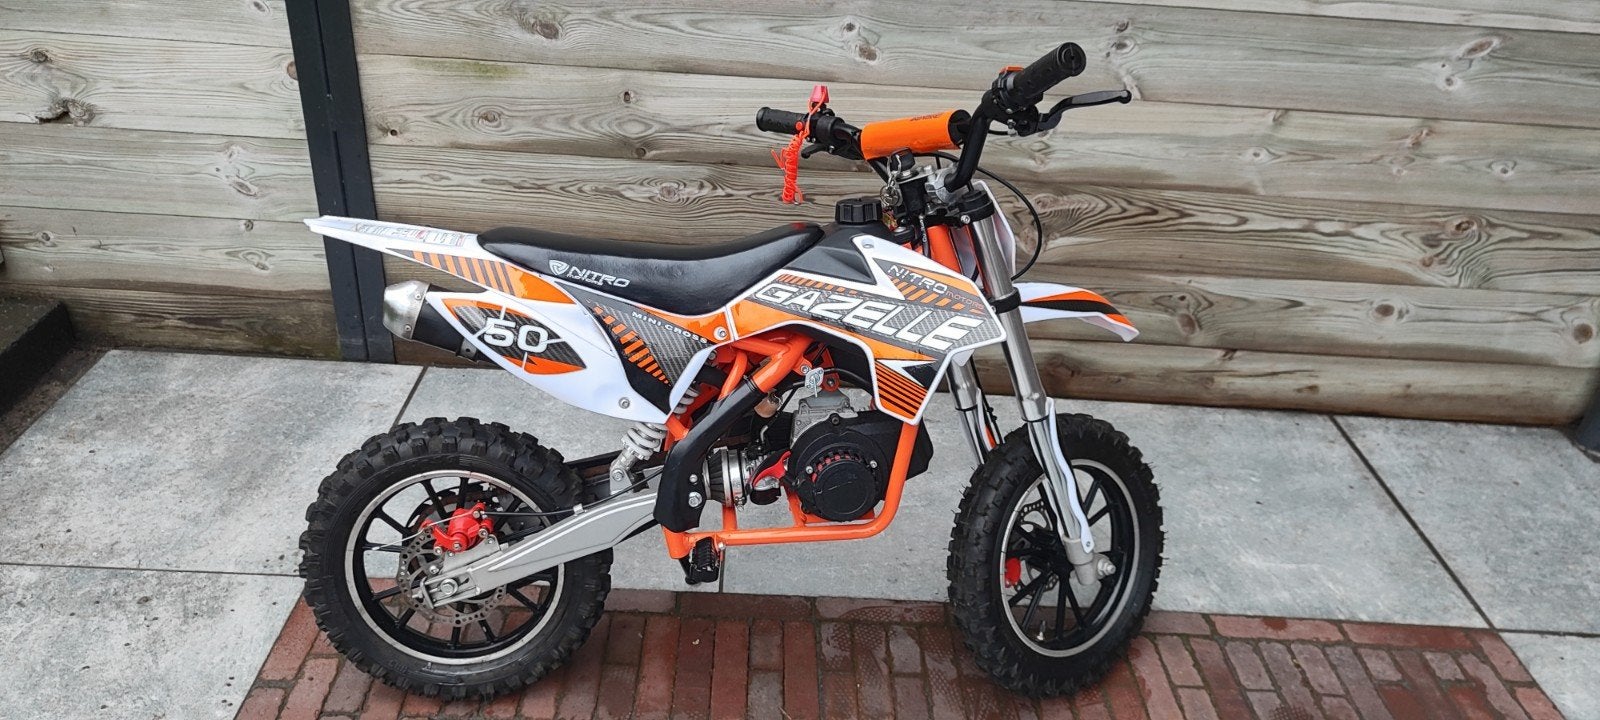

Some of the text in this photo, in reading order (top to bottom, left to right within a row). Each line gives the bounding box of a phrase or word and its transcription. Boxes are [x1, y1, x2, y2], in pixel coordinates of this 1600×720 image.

[567, 265, 631, 288] NITRO
[887, 264, 948, 294] NITRO
[631, 311, 709, 344] MINI CROSS
[754, 282, 985, 351] GAZELLE
[483, 317, 549, 353] 50
